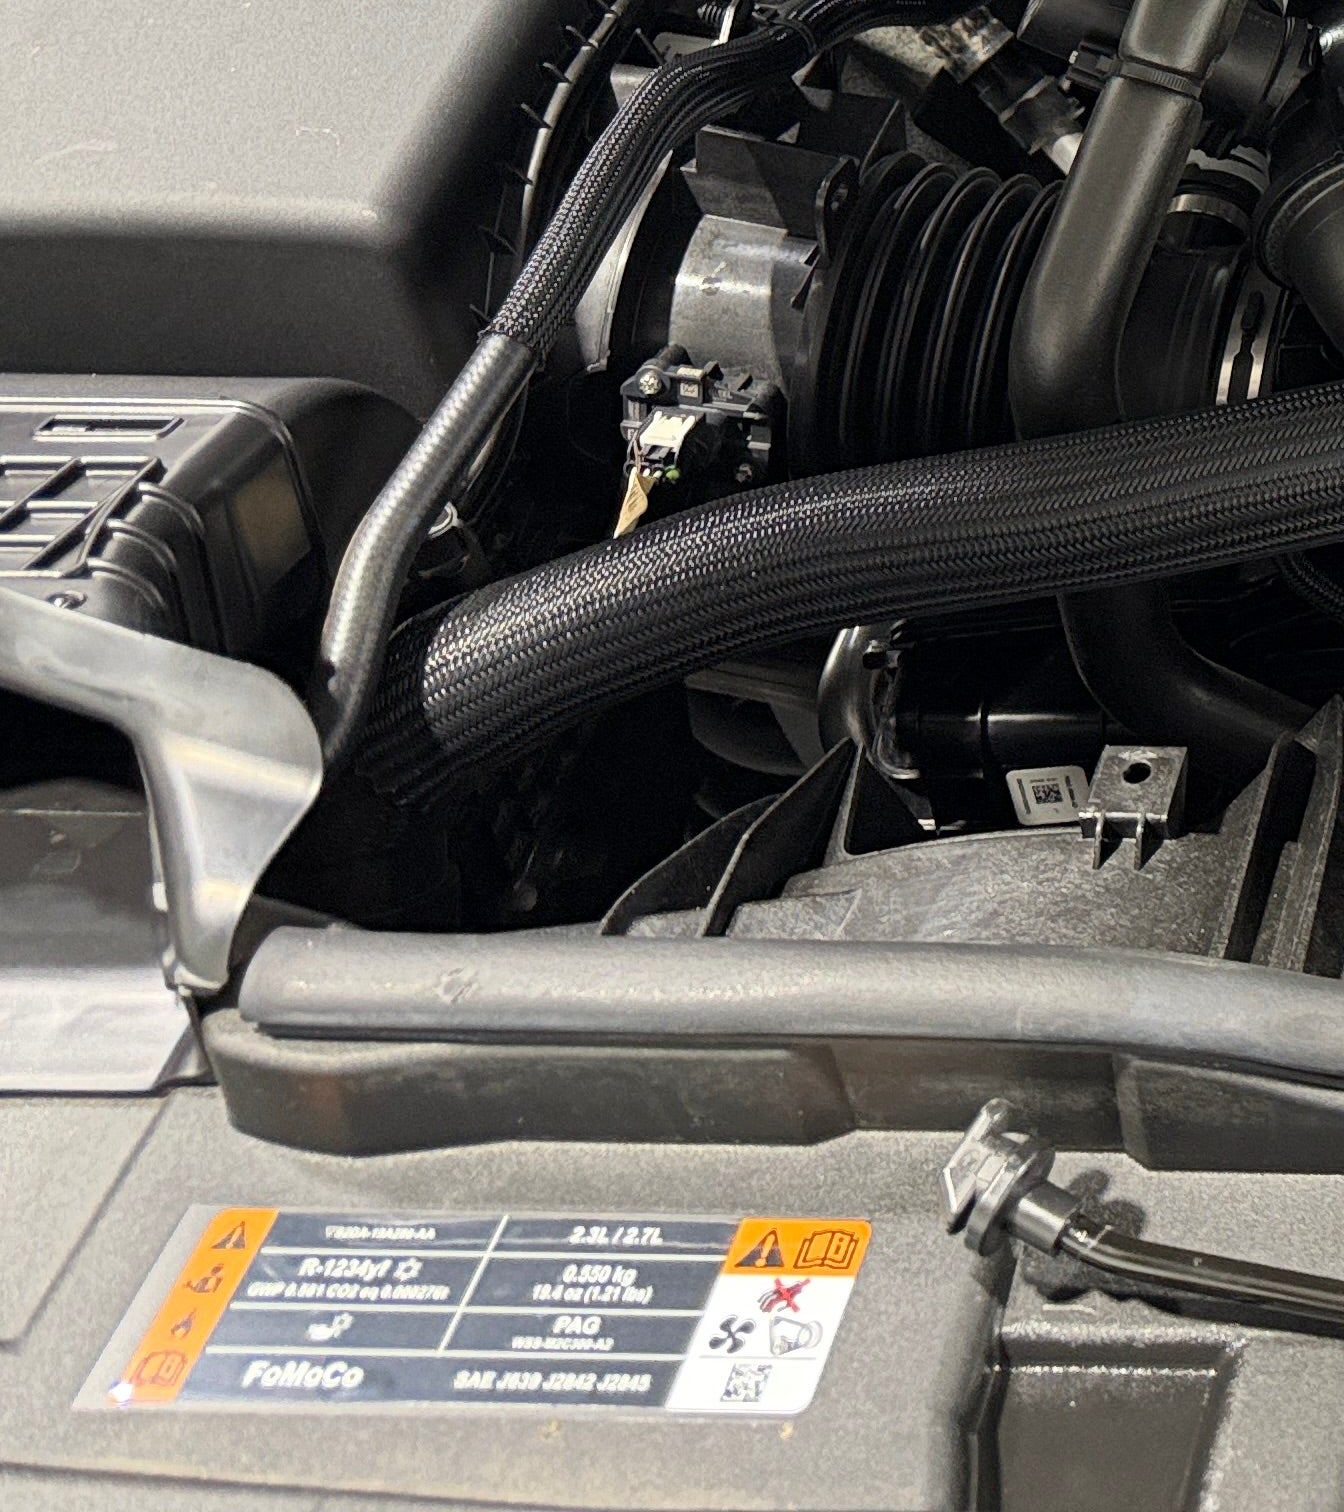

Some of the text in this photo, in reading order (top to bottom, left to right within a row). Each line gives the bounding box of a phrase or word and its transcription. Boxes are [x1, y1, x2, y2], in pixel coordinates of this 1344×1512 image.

[568, 1226, 609, 1245] 2.3L
[622, 1227, 664, 1245] 2.7L
[298, 1257, 393, 1282] R-1234yf
[611, 1266, 638, 1287] kg
[552, 1316, 602, 1335] PAG
[241, 1360, 365, 1389] FoMoCo
